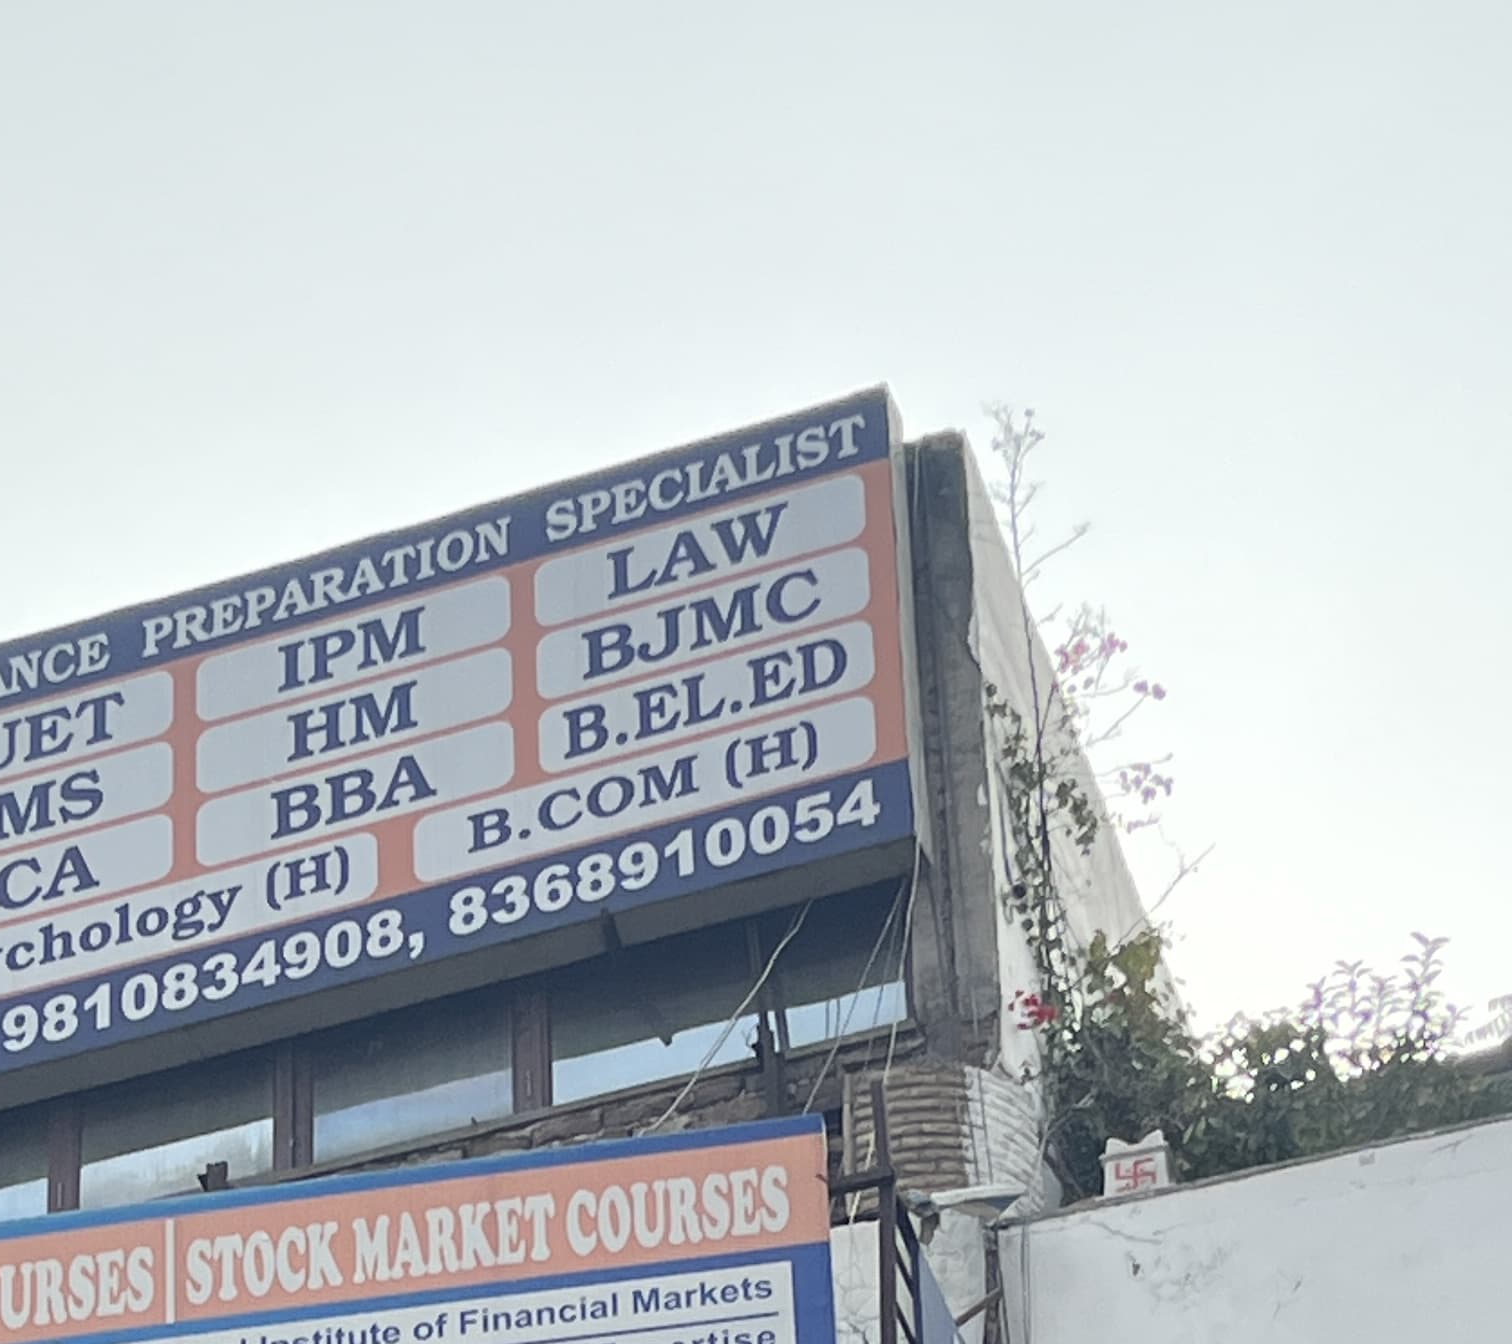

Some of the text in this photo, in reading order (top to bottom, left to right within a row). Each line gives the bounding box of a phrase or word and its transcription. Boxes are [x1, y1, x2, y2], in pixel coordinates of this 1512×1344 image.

[141, 515, 511, 659] PREPARATION
[545, 414, 866, 544] SPECIALIST
[606, 501, 790, 600] LAW
[278, 606, 428, 694] IPM
[580, 569, 821, 681] BJMC
[287, 681, 419, 764] HM
[561, 638, 850, 762] B.EL.ED
[270, 756, 437, 841] BBA
[466, 729, 819, 853] B.COM (H)
[2, 908, 426, 1056] 9810834908,
[448, 778, 882, 939] 8368910054
[264, 845, 352, 912] (H)
[184, 1163, 791, 1306] STOCK MARKET COURSES
[412, 1312, 449, 1342] of
[458, 1292, 619, 1337] Financial
[631, 1274, 774, 1316] Markets
